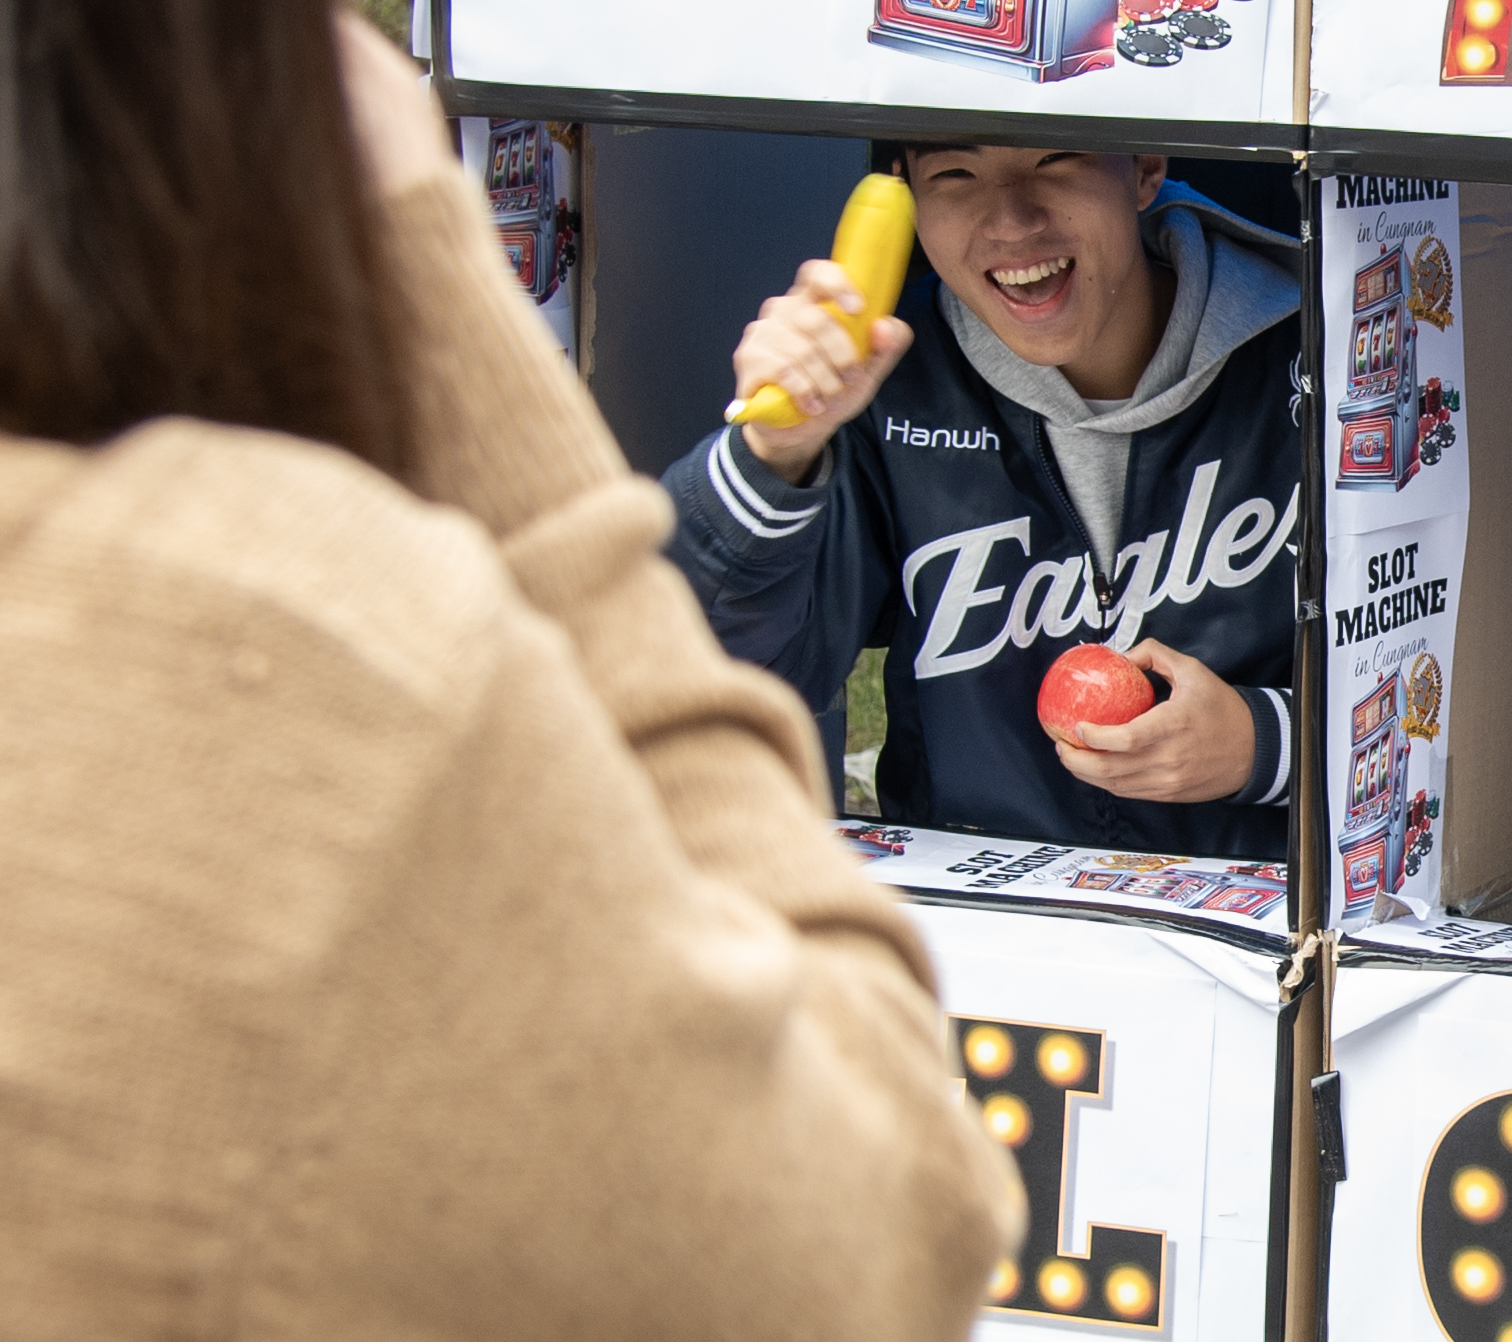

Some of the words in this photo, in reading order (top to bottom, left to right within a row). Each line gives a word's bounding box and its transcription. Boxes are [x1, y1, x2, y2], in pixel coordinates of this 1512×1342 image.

[1357, 221, 1372, 244] in
[903, 459, 1300, 680] Eagle
[1368, 542, 1419, 594] SLOT
[1335, 577, 1448, 648] MACHINE
[946, 850, 1015, 876] SLOT
